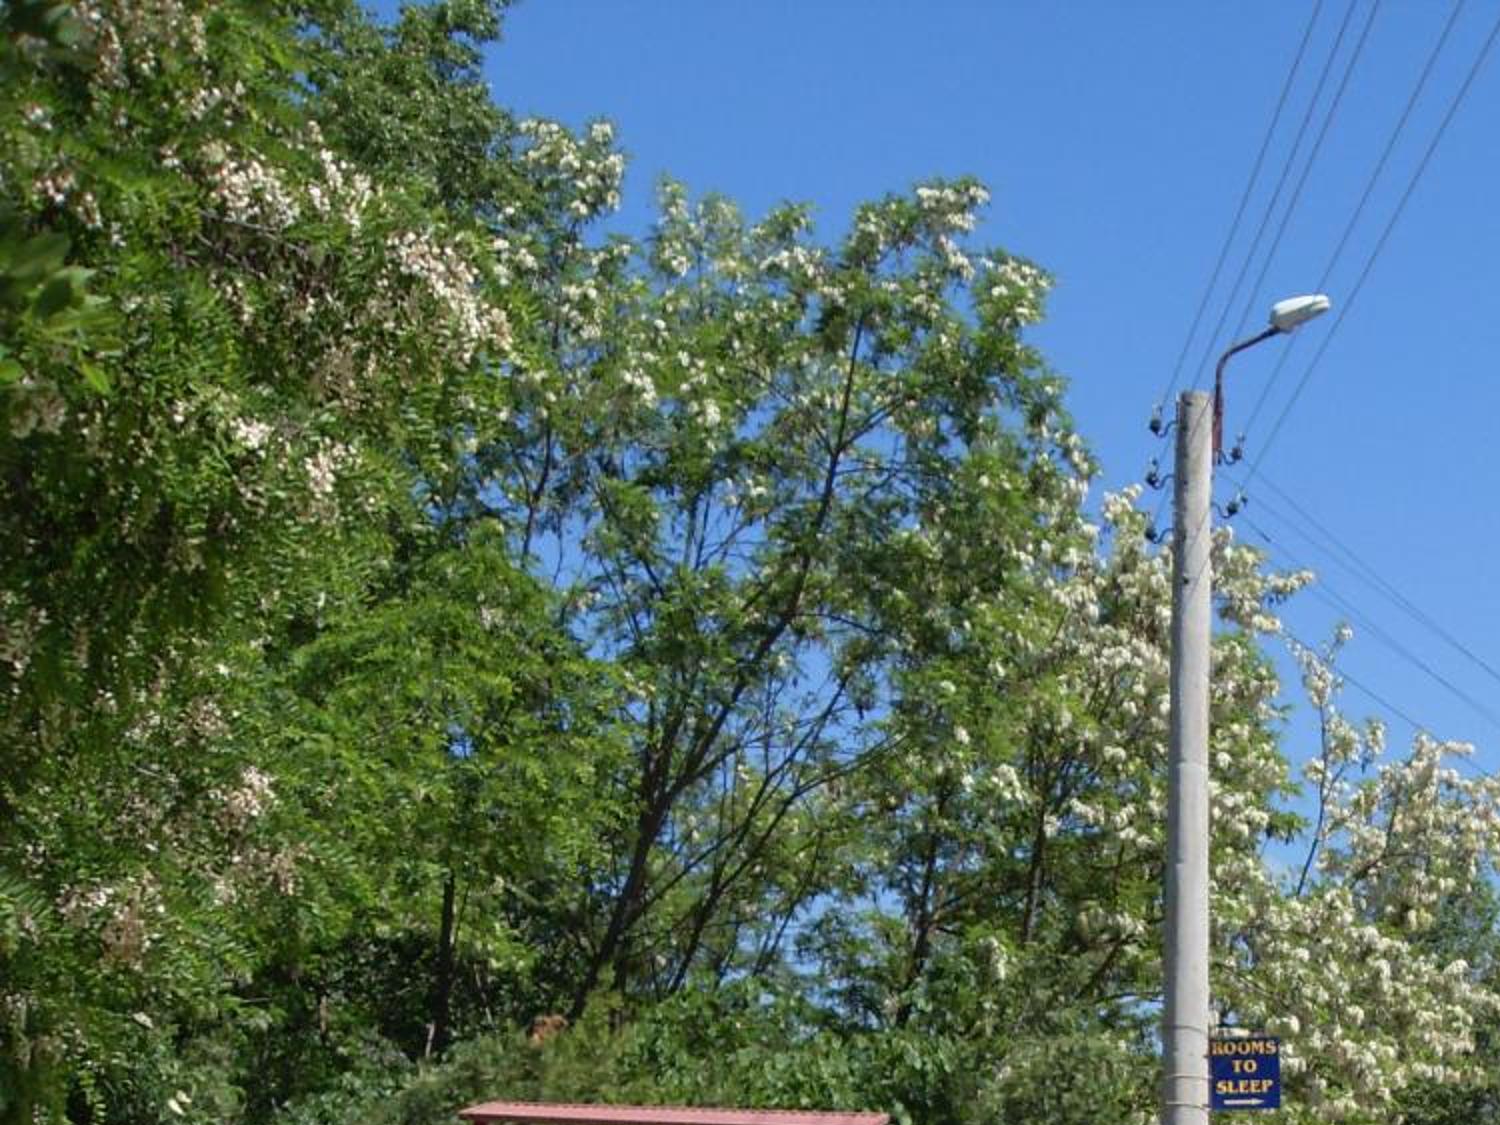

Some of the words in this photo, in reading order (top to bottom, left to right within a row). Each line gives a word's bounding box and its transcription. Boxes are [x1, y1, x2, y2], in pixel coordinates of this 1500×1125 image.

[1212, 1041, 1277, 1055] ROOMS
[1232, 1060, 1257, 1073] TO
[1216, 1080, 1273, 1093] SLEEP
